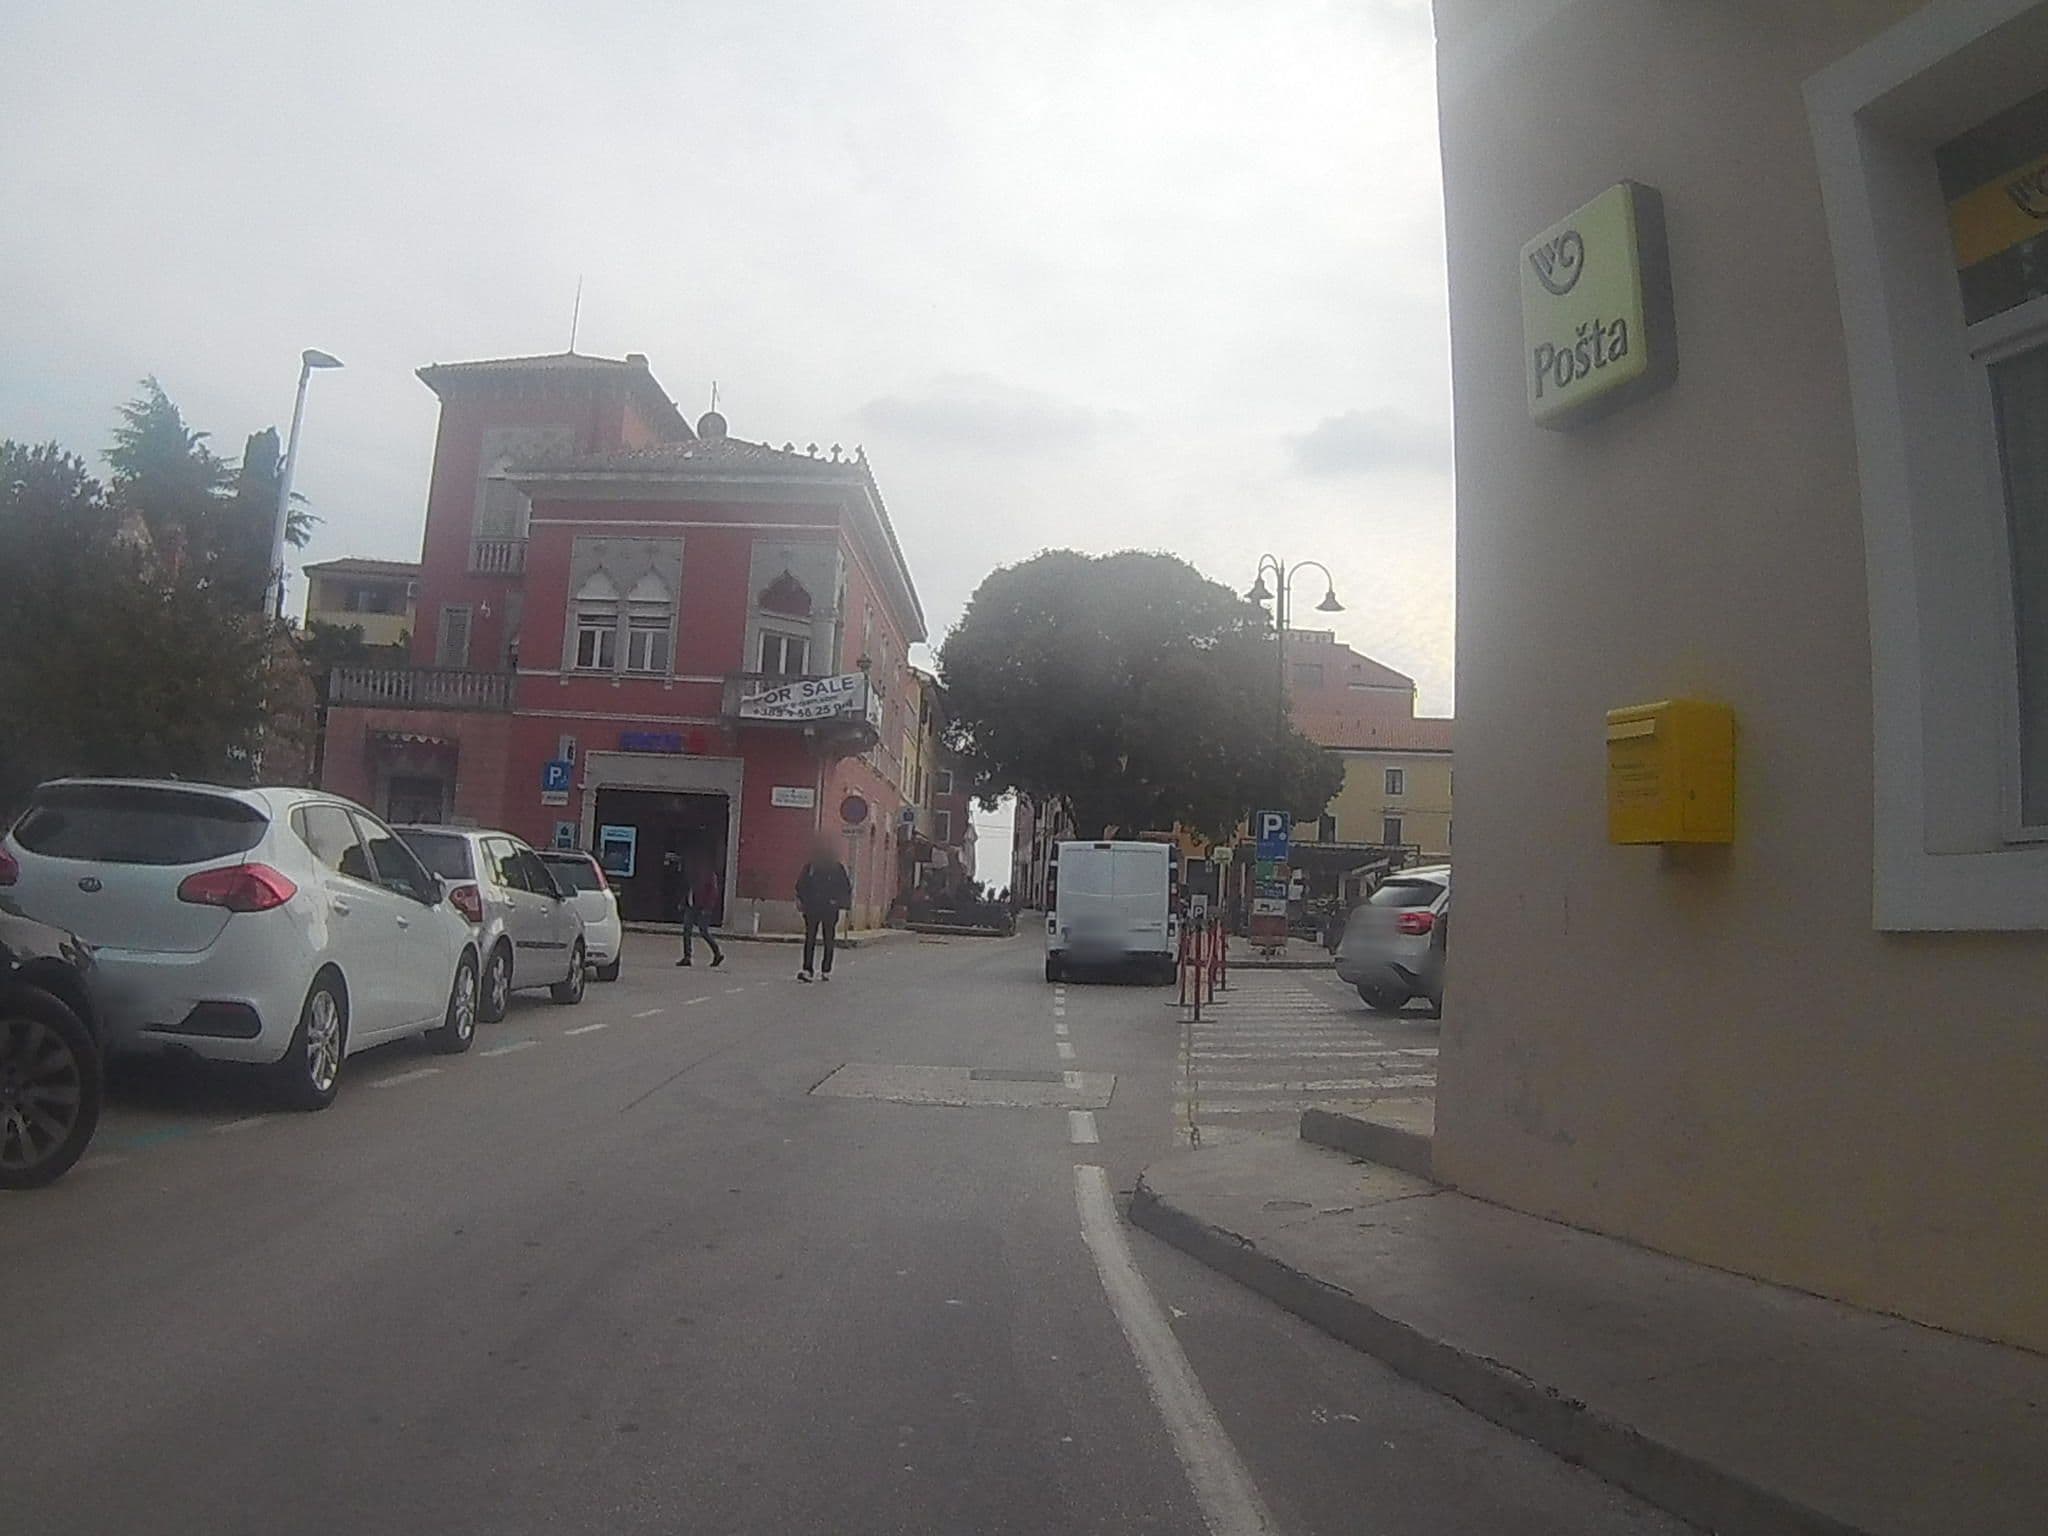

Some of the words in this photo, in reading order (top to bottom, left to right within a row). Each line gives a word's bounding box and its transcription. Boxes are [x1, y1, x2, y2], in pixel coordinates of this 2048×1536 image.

[1534, 317, 1628, 397] Pošta
[802, 677, 854, 697] SALE
[549, 765, 562, 785] P
[1263, 814, 1282, 840] P
[1195, 906, 1203, 917] P
